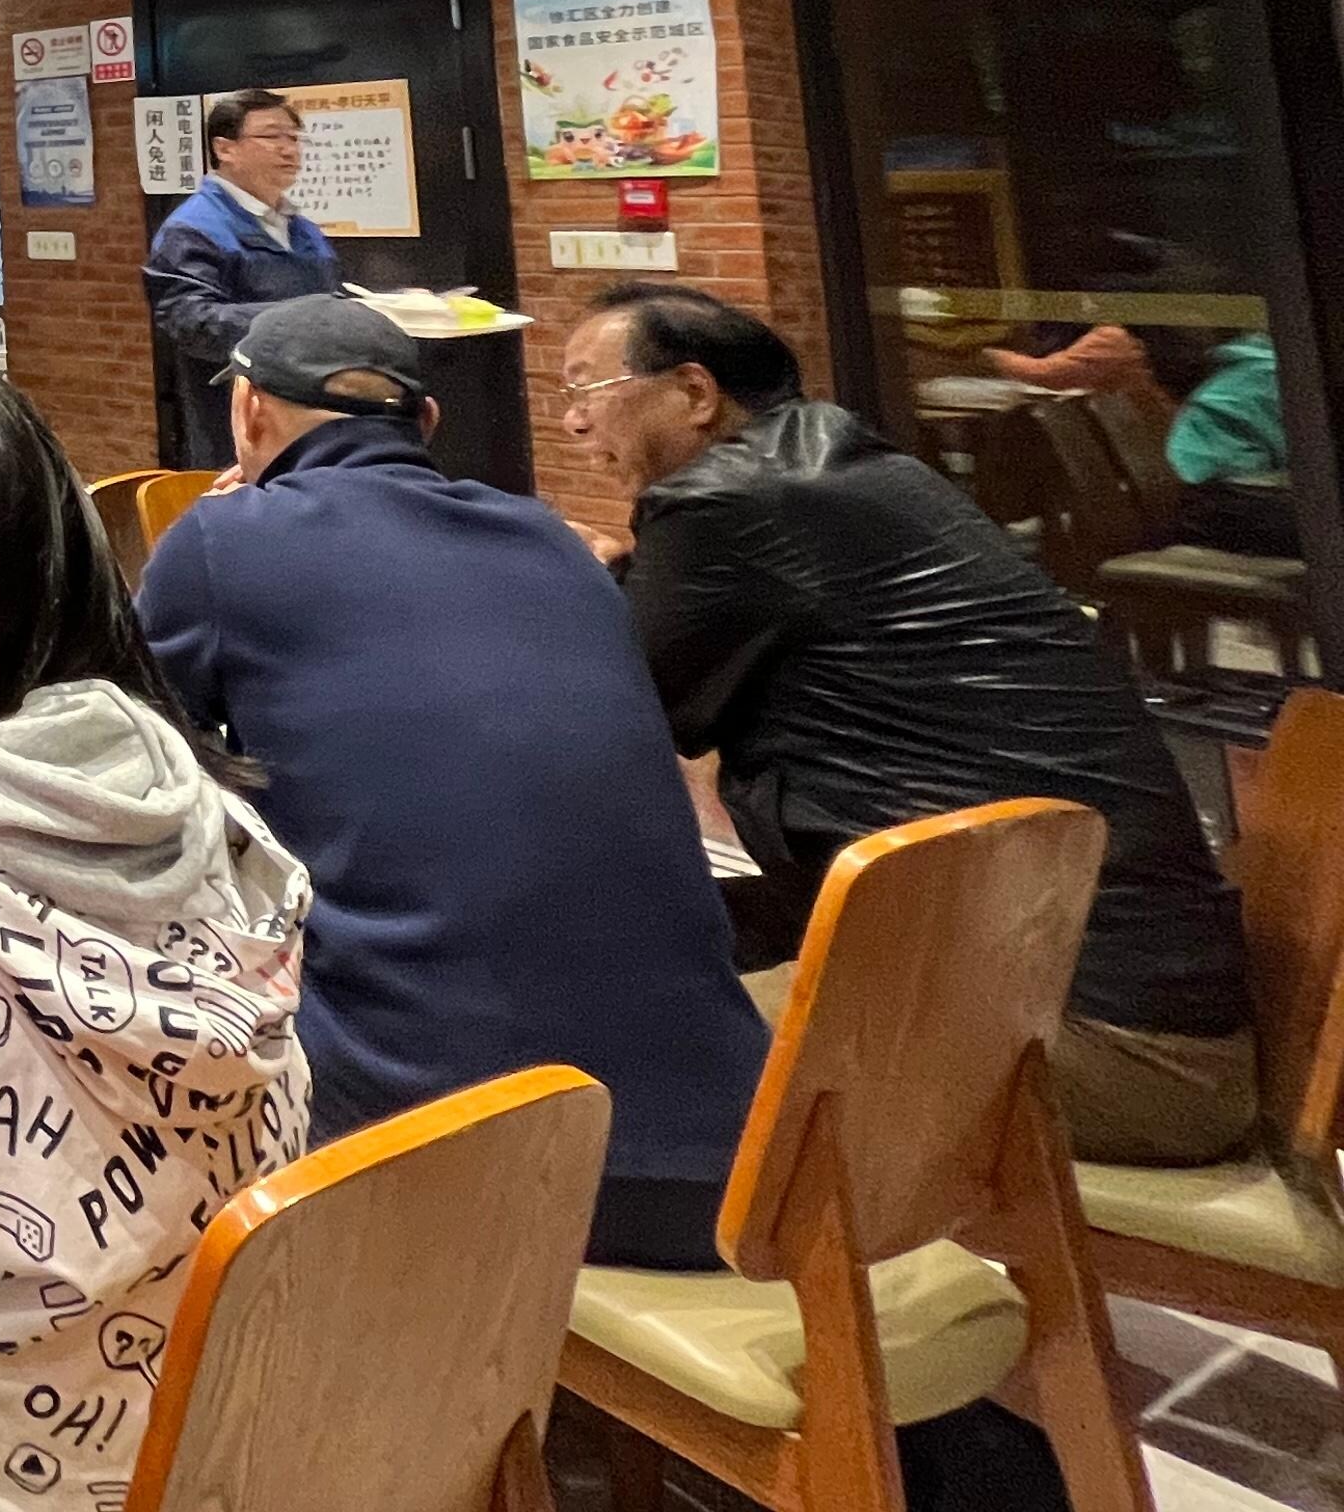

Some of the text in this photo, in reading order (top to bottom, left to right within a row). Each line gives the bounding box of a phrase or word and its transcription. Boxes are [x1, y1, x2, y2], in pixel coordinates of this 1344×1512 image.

[145, 109, 168, 182] 闲人免进
[175, 99, 196, 191] 配电房重地
[79, 952, 118, 1025] TALK
[23, 1384, 128, 1452] OH!
